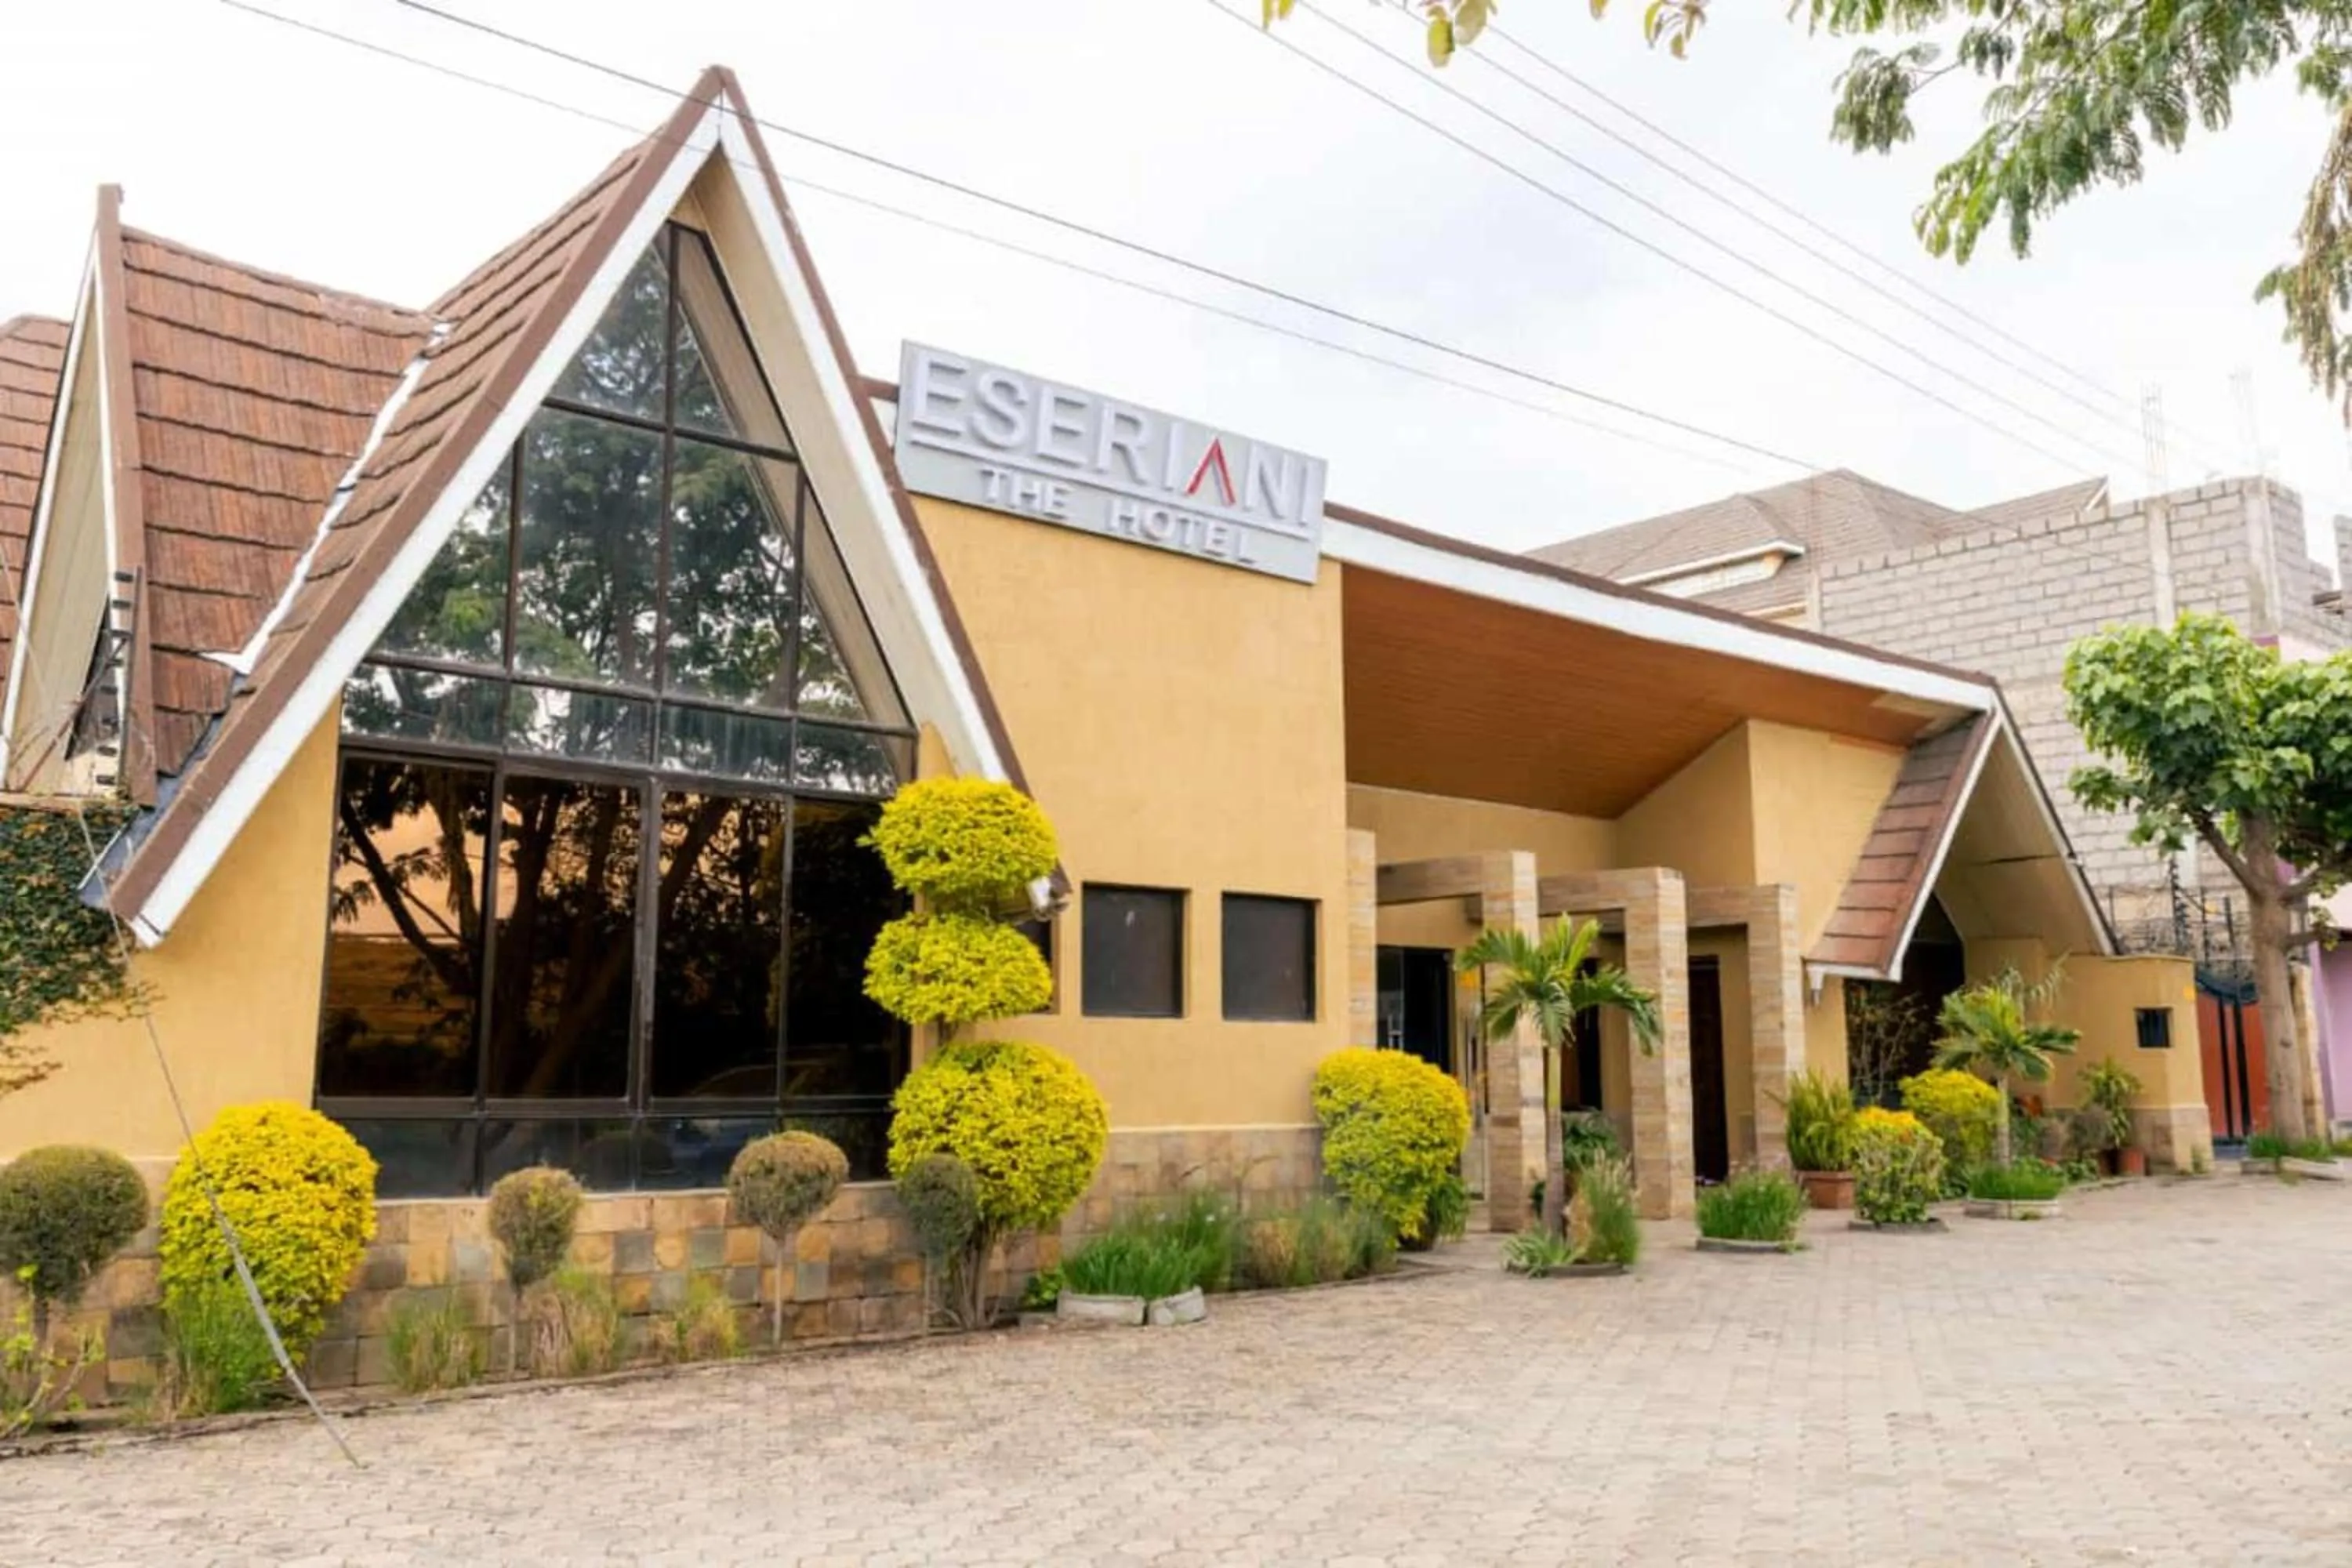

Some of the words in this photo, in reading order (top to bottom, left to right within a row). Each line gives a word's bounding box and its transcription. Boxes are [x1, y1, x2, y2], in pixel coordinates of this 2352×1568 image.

[911, 350, 1319, 526] ESERIANI
[980, 468, 1075, 520] THE
[1106, 493, 1256, 564] HOTEL
